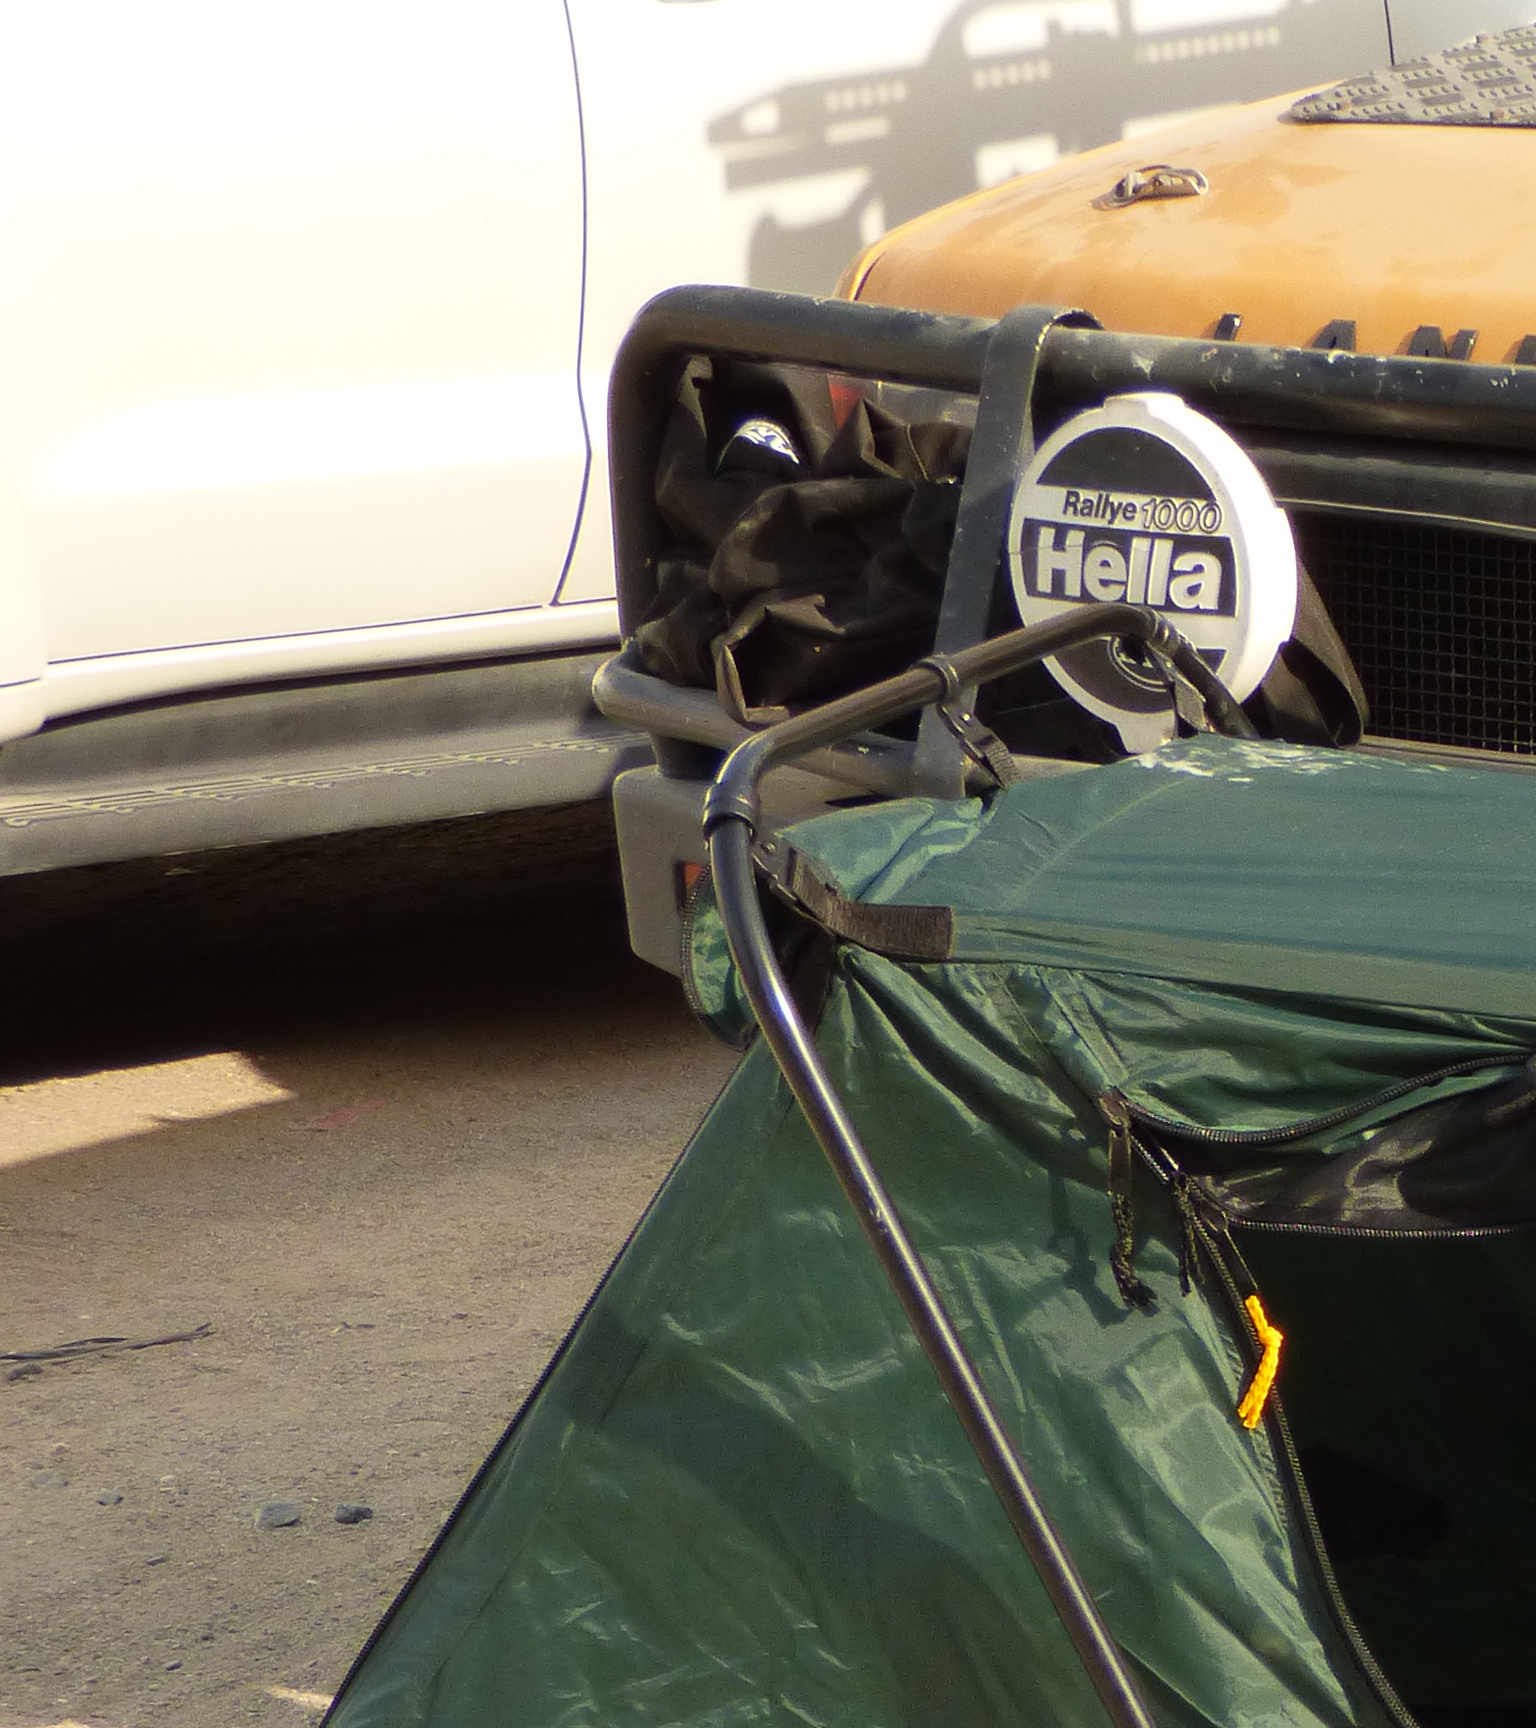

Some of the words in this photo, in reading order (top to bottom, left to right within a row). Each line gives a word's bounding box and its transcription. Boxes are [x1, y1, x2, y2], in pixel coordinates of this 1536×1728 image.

[1063, 490, 1137, 525] Rallye
[1142, 497, 1222, 534] 1000
[1036, 526, 1223, 611] Hella
